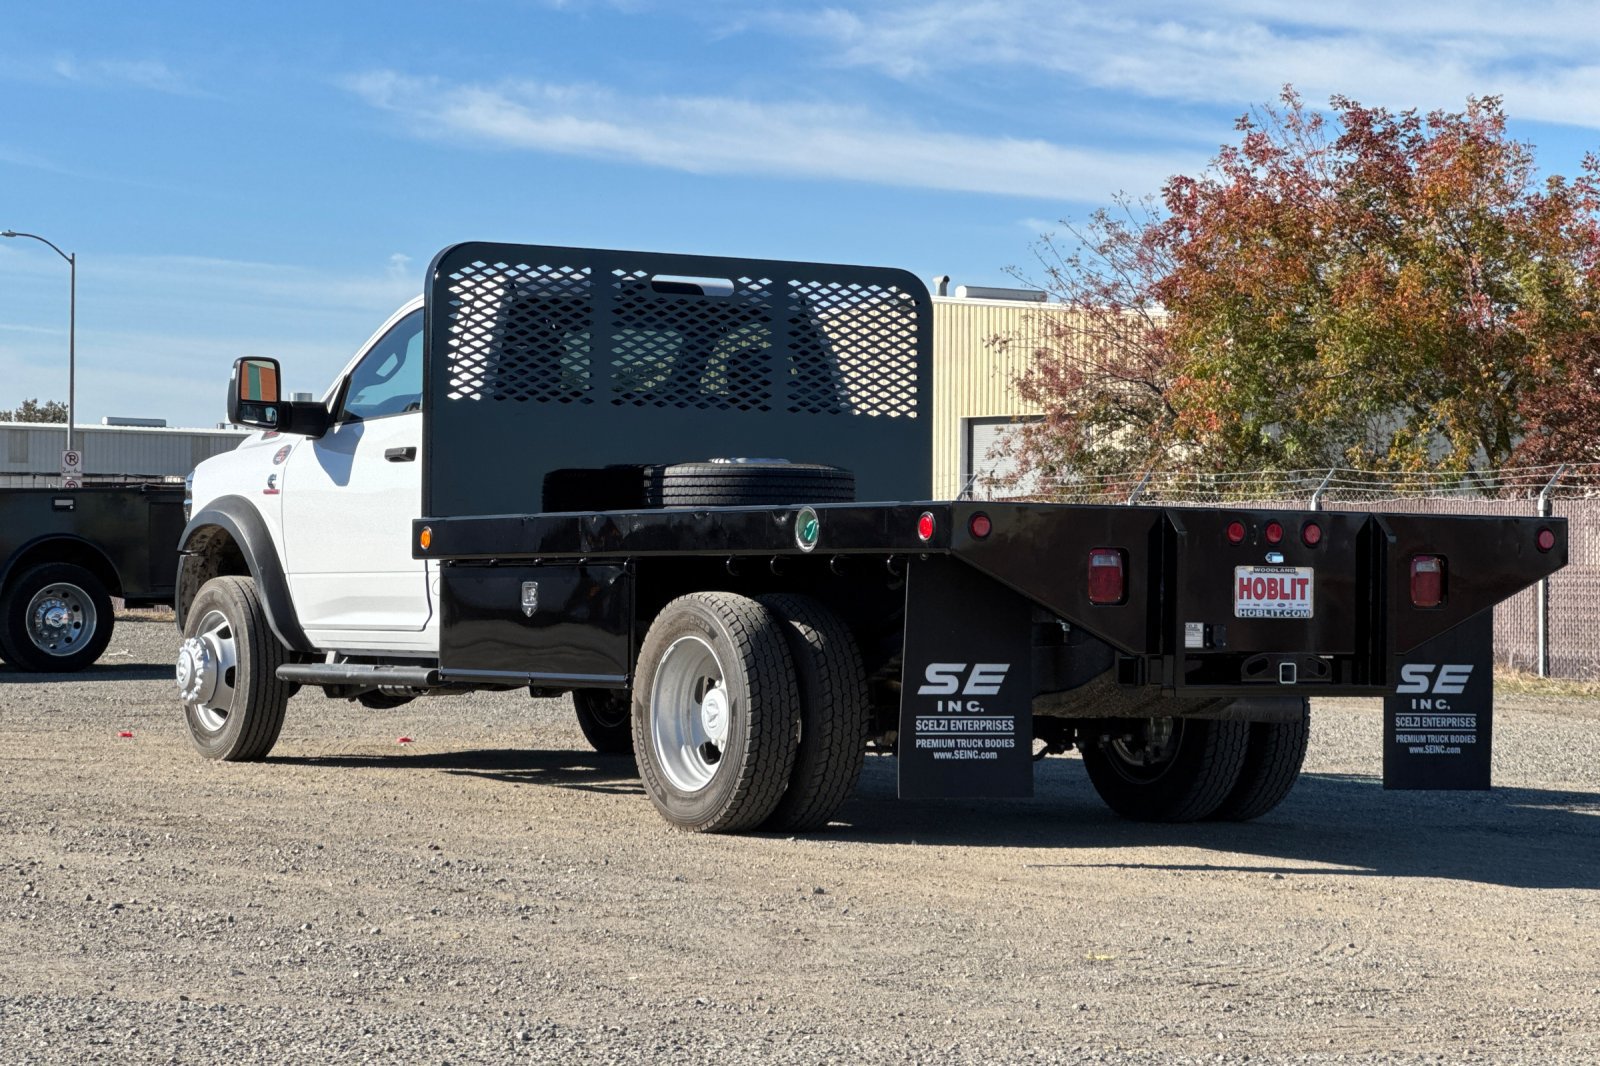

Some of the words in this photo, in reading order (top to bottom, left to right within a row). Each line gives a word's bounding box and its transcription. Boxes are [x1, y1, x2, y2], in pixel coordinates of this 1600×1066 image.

[1238, 577, 1309, 600] HOBLIT
[1239, 609, 1310, 617] HOBLIT.COM
[917, 662, 1011, 695] SE
[1395, 663, 1474, 694] SE
[937, 700, 985, 712] INC.
[1411, 698, 1451, 710] INC.
[915, 720, 948, 731] SCELZI
[950, 720, 1014, 731] ENTERPRISES
[1395, 716, 1421, 727] SCELZI
[1422, 717, 1477, 728] ENTERPRISES
[915, 738, 956, 748] PREMIUM
[956, 739, 983, 748] TRUCK
[984, 739, 1015, 748] BODIES
[1395, 734, 1426, 743] PREMIUM
[1427, 734, 1449, 743] TRUCK
[1450, 734, 1477, 744] BODIES
[933, 749, 998, 759] www.SEINC.com
[1409, 744, 1461, 754] www.SEINC.com
